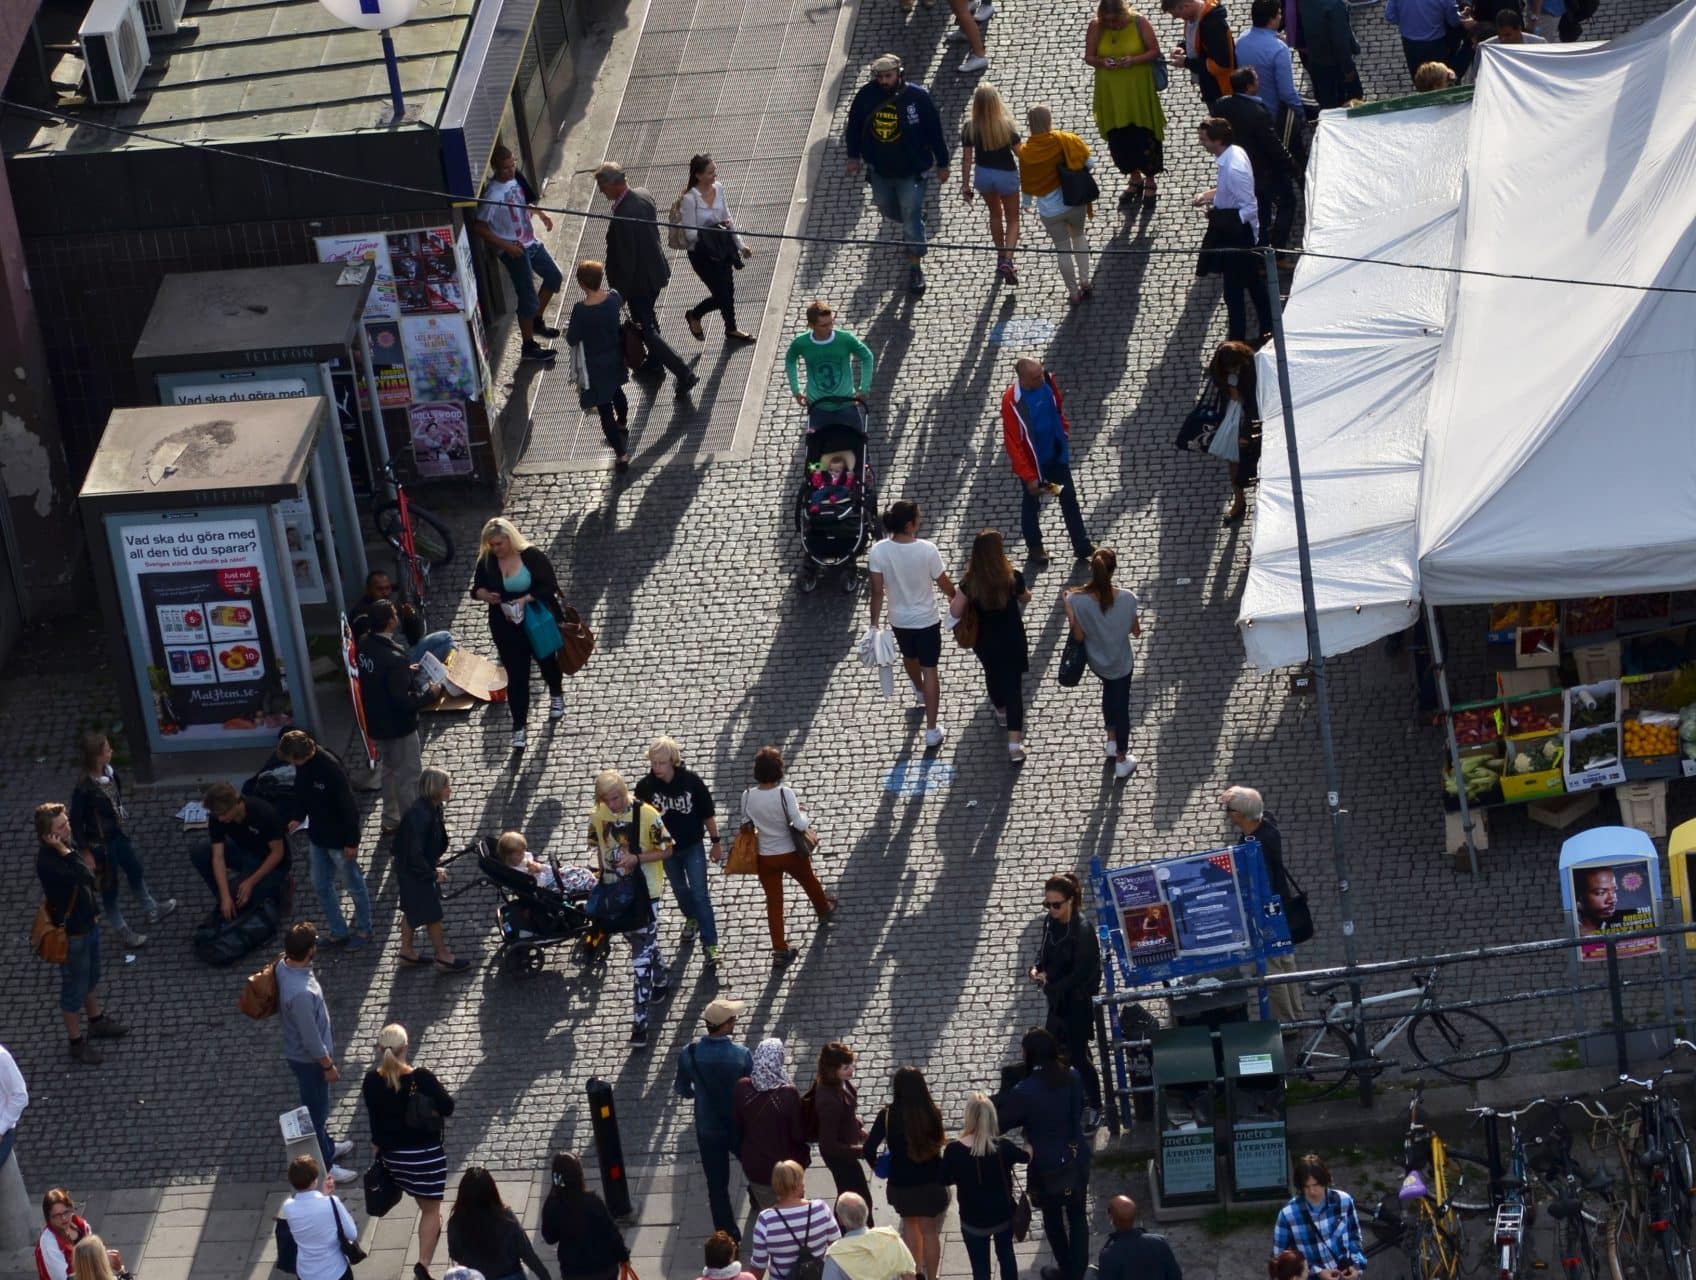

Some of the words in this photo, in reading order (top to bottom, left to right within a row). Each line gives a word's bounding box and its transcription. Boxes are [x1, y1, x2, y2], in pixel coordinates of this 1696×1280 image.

[876, 111, 899, 119] TYRELL
[244, 347, 314, 362] TELEFON
[125, 534, 150, 546] Vad
[153, 534, 174, 545] ska
[178, 533, 193, 543] du
[197, 532, 224, 544] göra
[228, 529, 256, 540] med
[130, 548, 143, 559] all
[147, 547, 170, 558] den
[173, 546, 189, 556] tid
[192, 545, 207, 555] du
[211, 542, 257, 556] sparar?
[1164, 1135, 1201, 1146] metro
[1235, 1129, 1273, 1140] metro
[1167, 1147, 1212, 1159] ÅTERVINN
